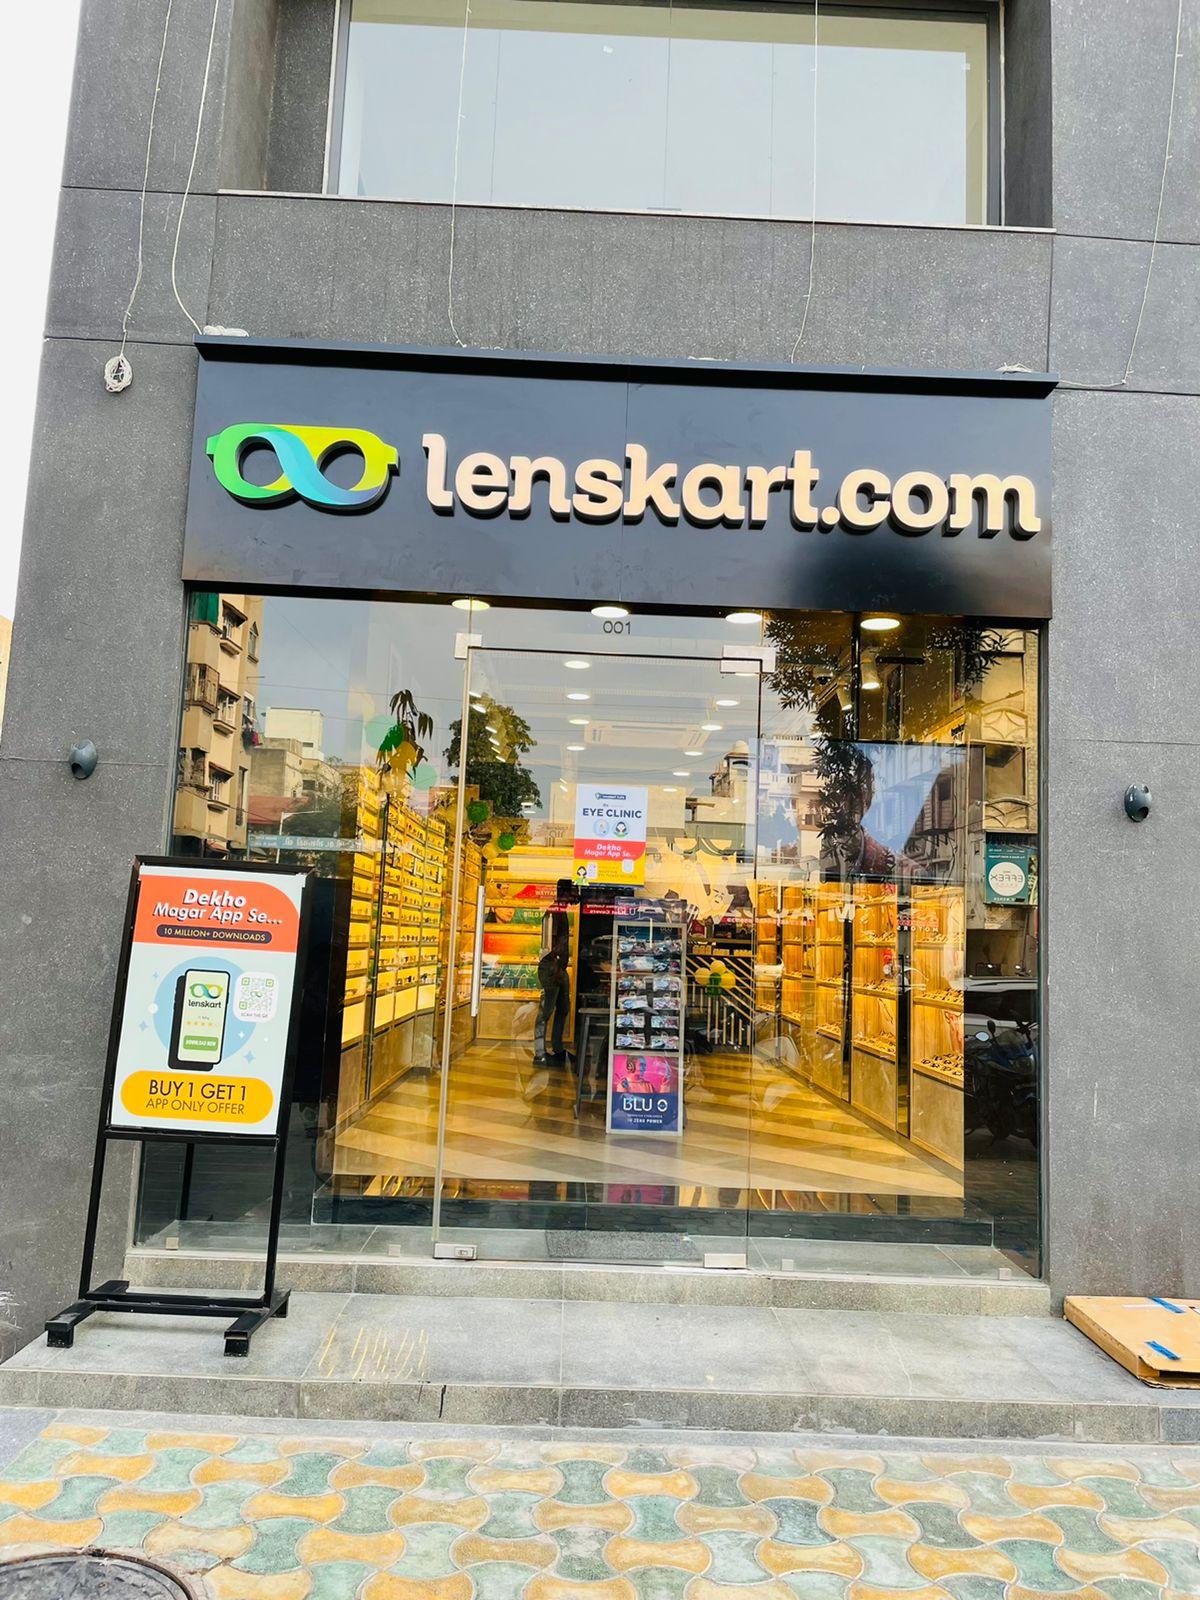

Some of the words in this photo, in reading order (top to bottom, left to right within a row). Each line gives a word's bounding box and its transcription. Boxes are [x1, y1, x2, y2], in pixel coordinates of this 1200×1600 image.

[421, 433, 1042, 537] lenskart.com
[603, 620, 631, 635] 001
[582, 808, 604, 817] EYE
[606, 809, 642, 818] CLINIC
[596, 843, 622, 852] Dekho
[607, 849, 621, 858] App
[183, 889, 247, 907] Dekho
[153, 902, 207, 921] Magar
[208, 906, 243, 925] App
[164, 928, 173, 936] 10
[212, 931, 266, 941] DOWNLOADS
[188, 999, 222, 1008] lenskart
[149, 1079, 184, 1096] BUY
[189, 1082, 194, 1097] 1
[200, 1083, 236, 1100] GET
[240, 1085, 246, 1101] 1
[146, 1098, 168, 1109] APP
[171, 1099, 205, 1112] ONLY
[207, 1101, 245, 1114] OFFER
[623, 1097, 653, 1111] BLU
